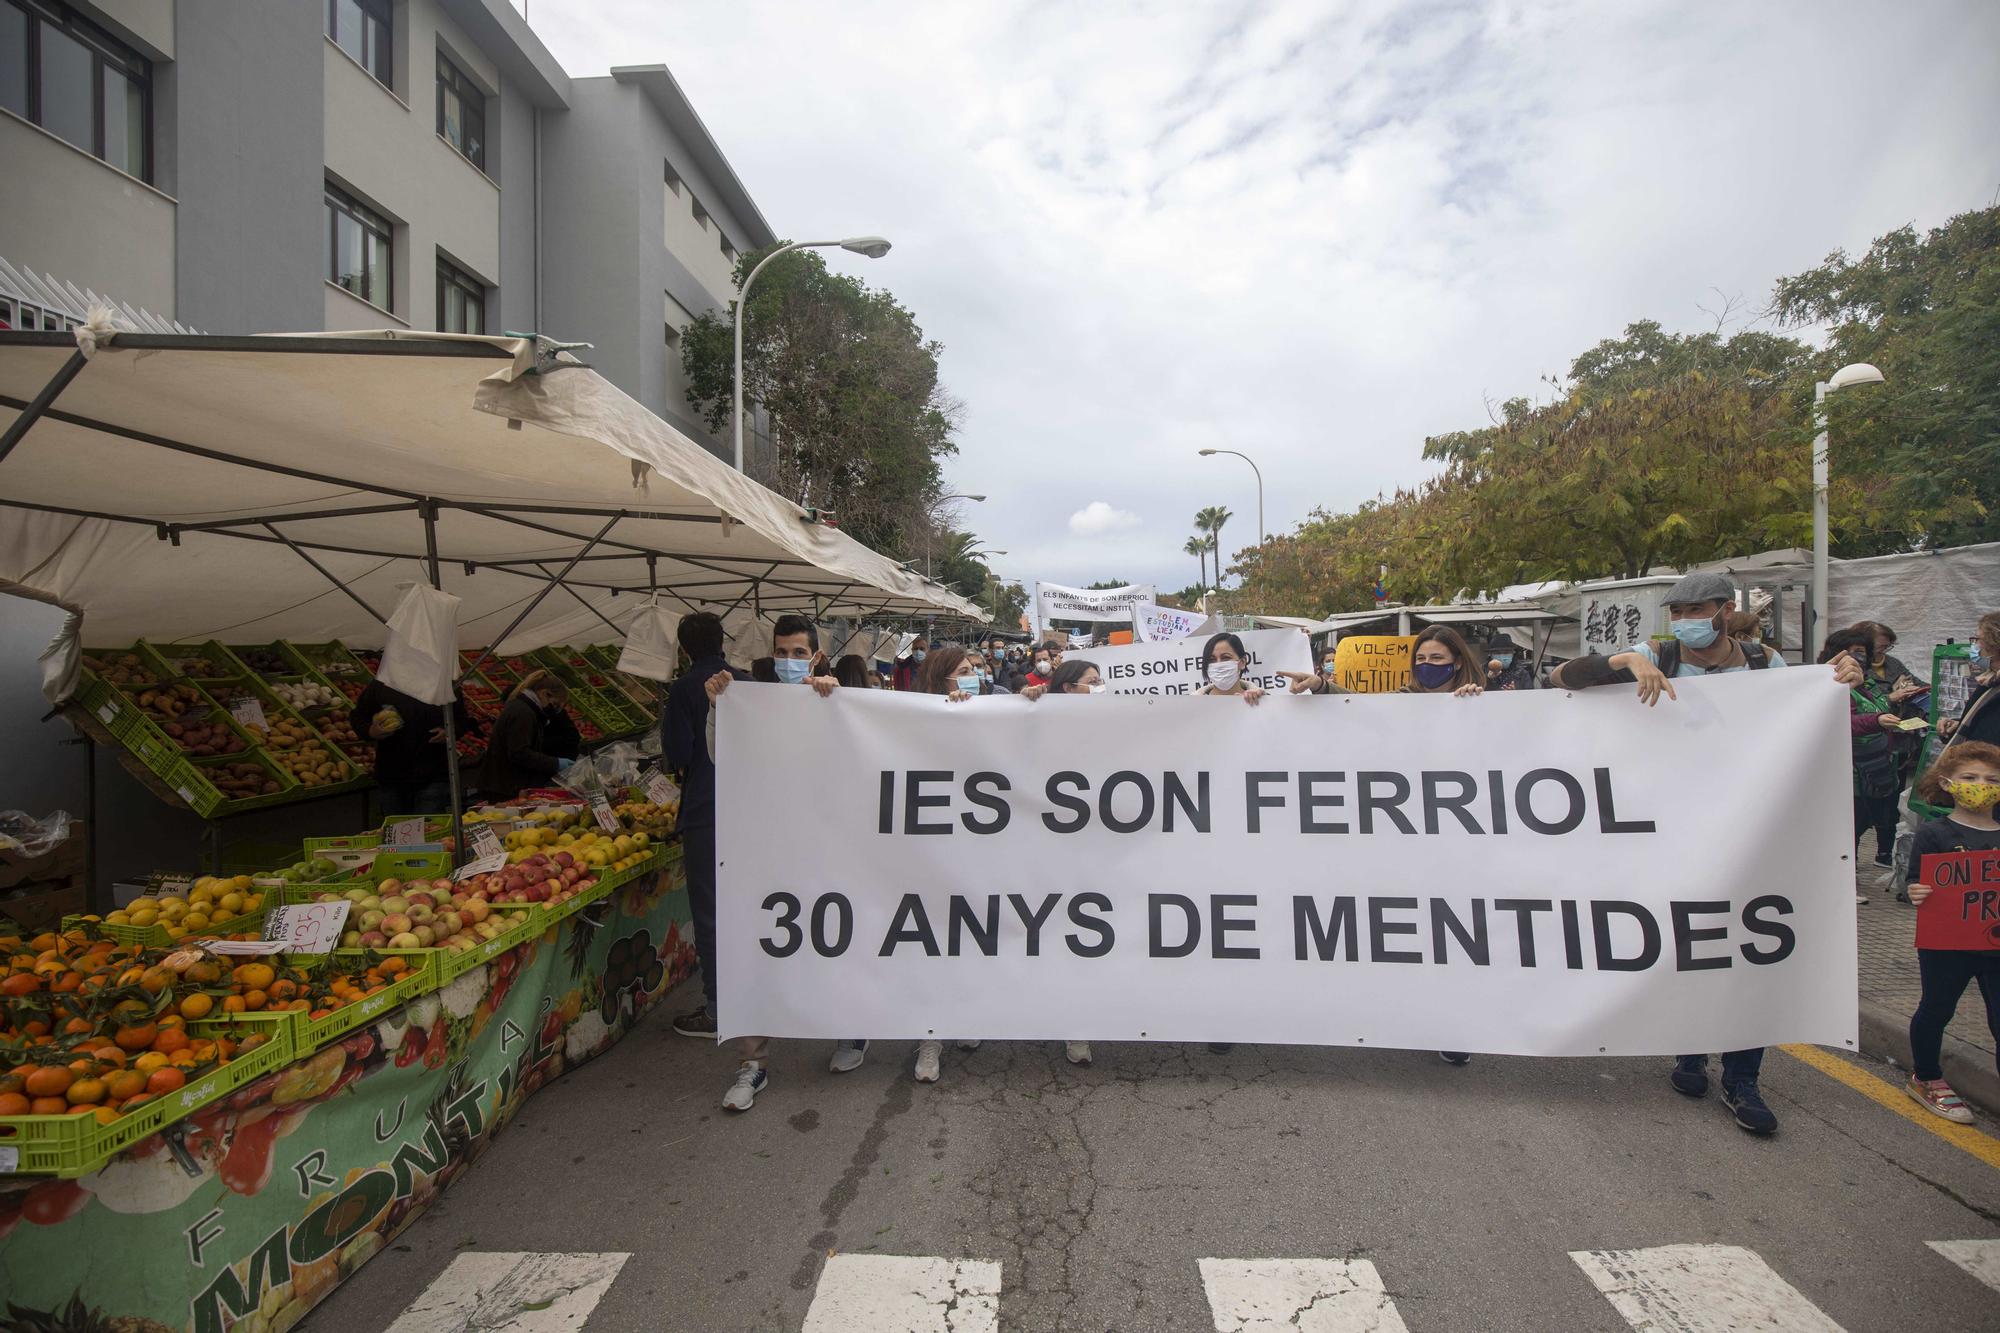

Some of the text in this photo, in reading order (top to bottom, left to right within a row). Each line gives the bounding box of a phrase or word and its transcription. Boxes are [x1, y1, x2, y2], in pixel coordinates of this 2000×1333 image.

[1043, 591, 1057, 599] ELS
[1058, 592, 1088, 601] INFANTS
[1102, 594, 1117, 602] SON
[1118, 593, 1150, 601] FERRIOL
[1053, 602, 1098, 612] NECESSITAM
[1147, 617, 1183, 631] ESTUDIAR
[1157, 612, 1189, 626] VOLEM
[1354, 643, 1409, 656] VOLEM
[1108, 664, 1136, 680] IES
[1141, 659, 1179, 676] SON
[1367, 658, 1391, 668] UN
[1165, 683, 1190, 695] DE
[878, 767, 1657, 836] IES SON FERRIOL
[1935, 858, 1971, 886] ON
[1962, 890, 2000, 921] PR
[759, 892, 1796, 972] 30 ANYS DE MENTIDES
